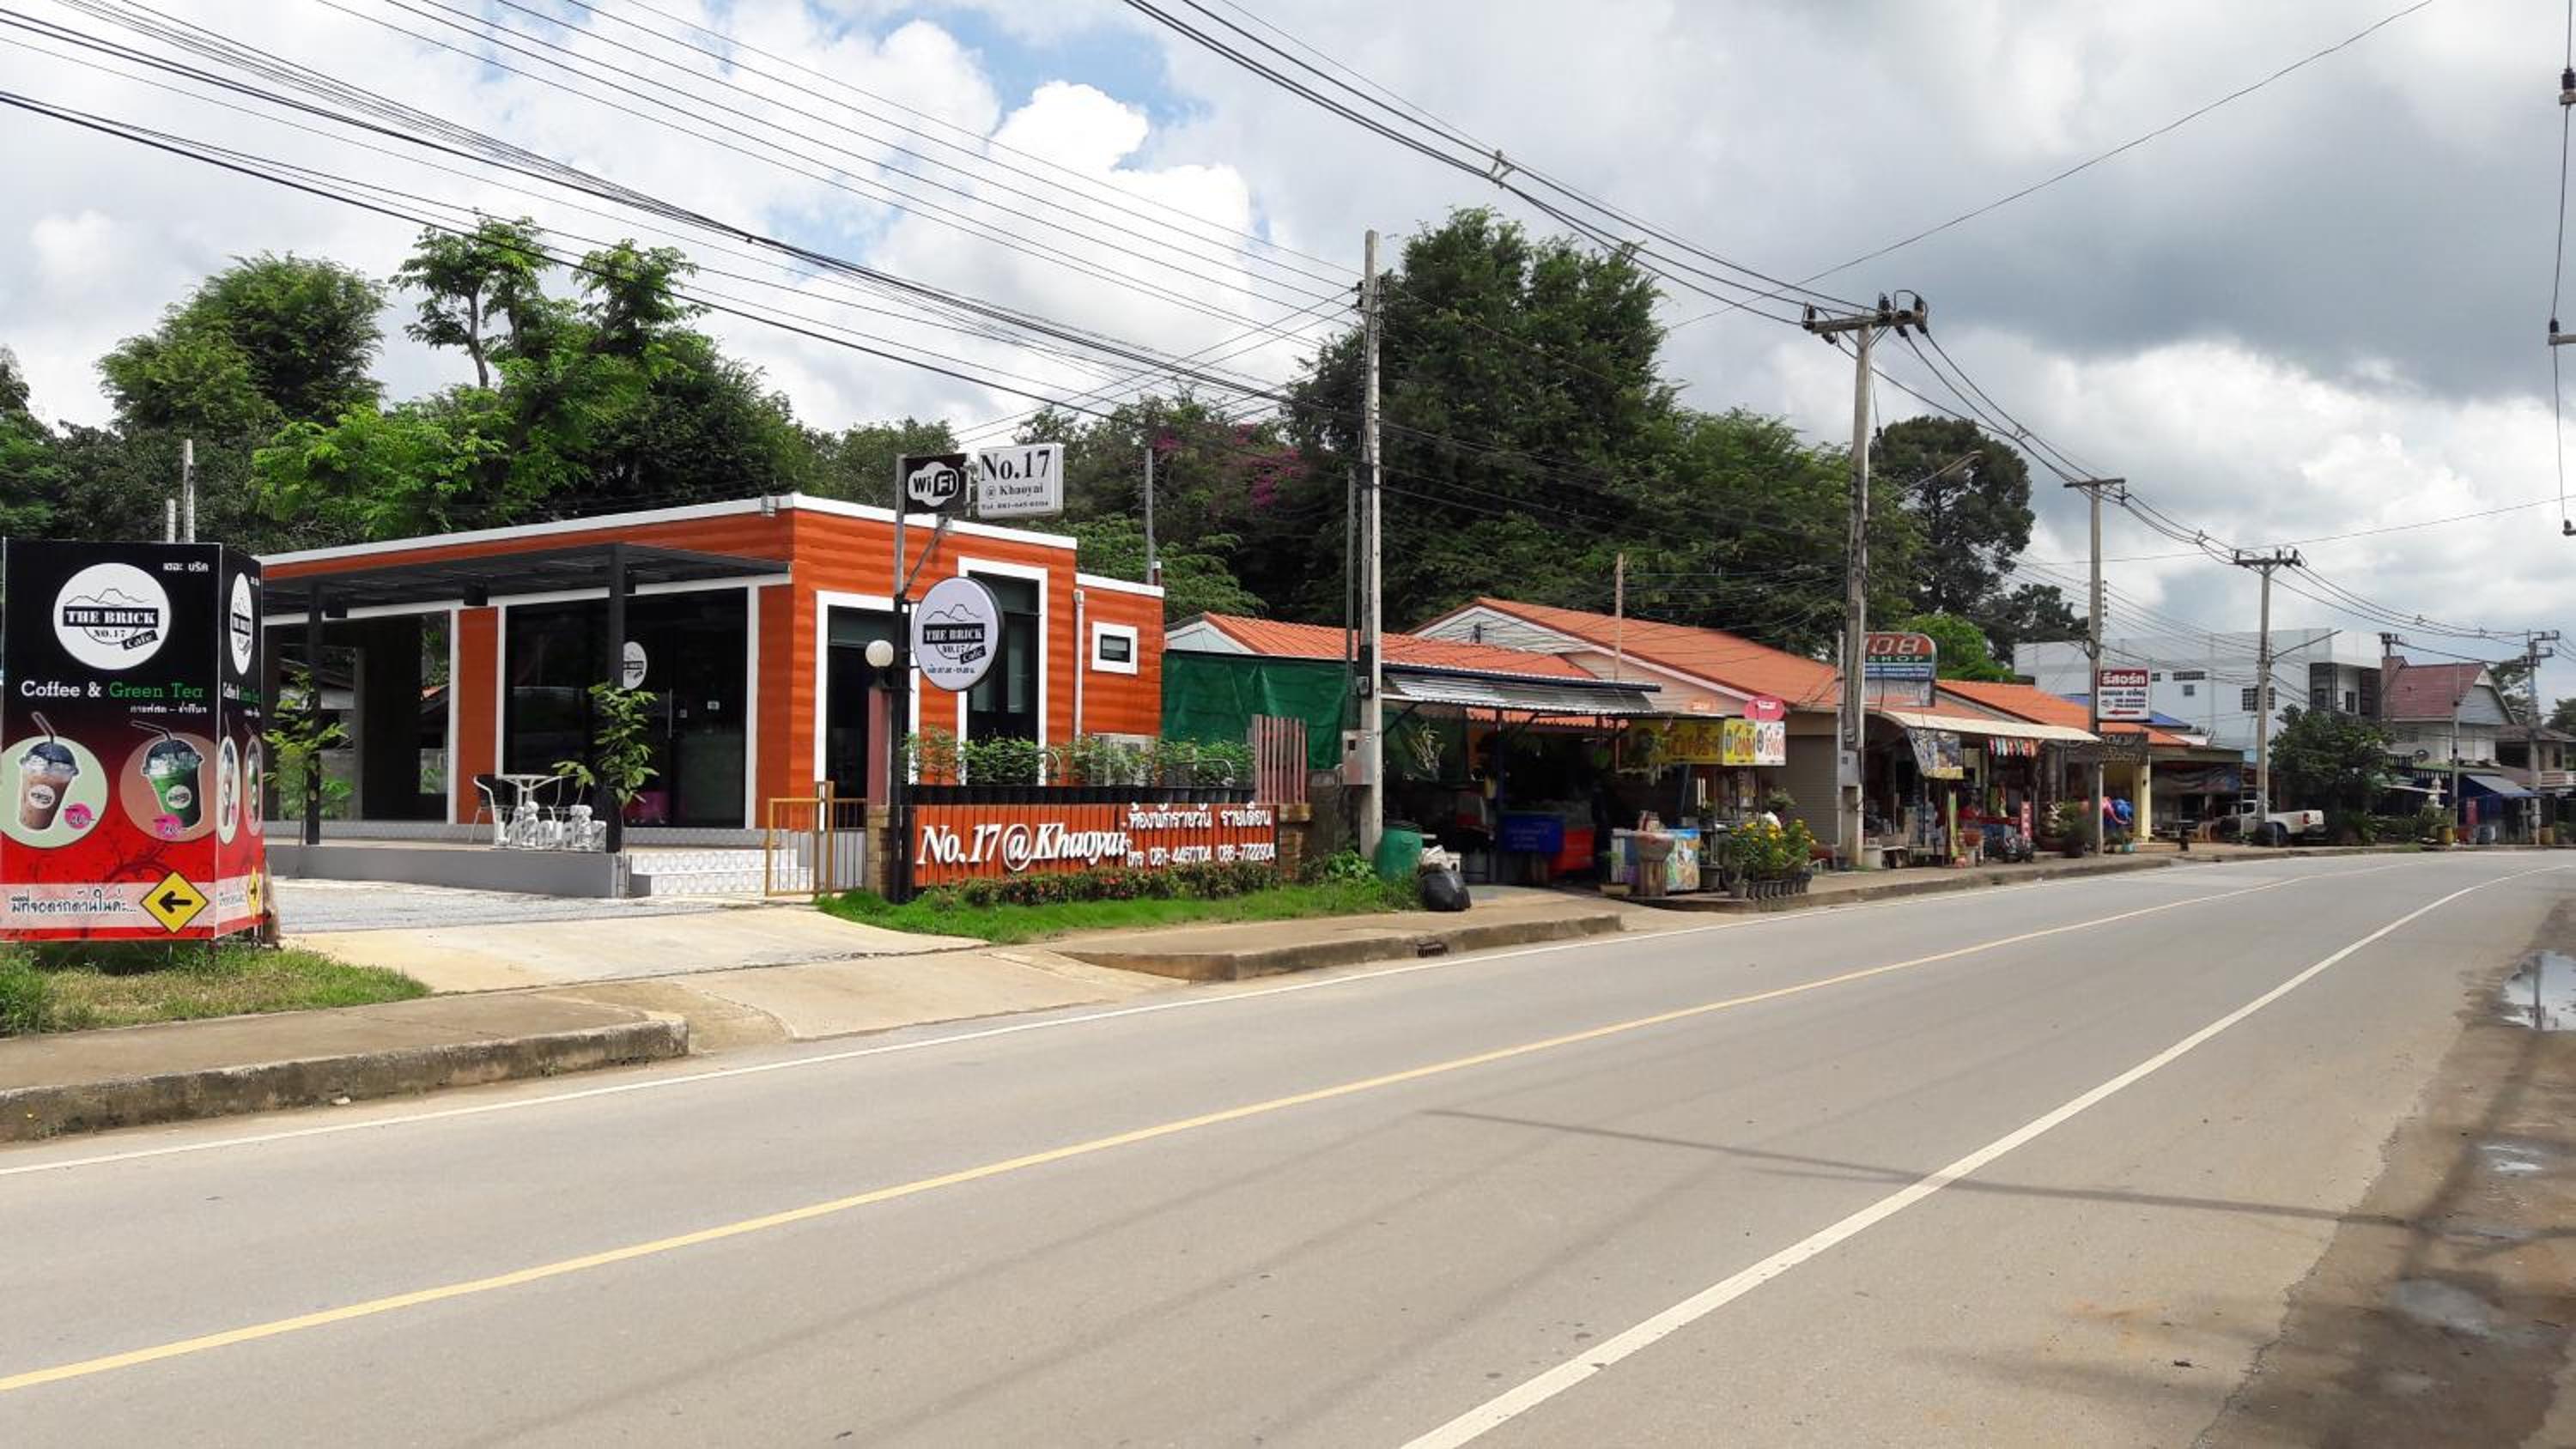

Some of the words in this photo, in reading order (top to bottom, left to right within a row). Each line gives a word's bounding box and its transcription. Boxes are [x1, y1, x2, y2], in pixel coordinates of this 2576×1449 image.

[980, 449, 1050, 482] No.17
[999, 483, 1043, 497] Khaoyai
[66, 609, 100, 624] THE
[104, 610, 156, 625] BRICK
[94, 629, 126, 638] NO.17
[926, 628, 947, 641] THE
[949, 627, 983, 640] BRICK
[2101, 672, 2146, 686] รีสอร์ท
[21, 680, 81, 698] Coffee
[88, 681, 102, 698] &
[109, 682, 164, 698] Green
[171, 682, 204, 698] Tea
[1127, 801, 1212, 829] ห้องพักรายวัน
[1220, 800, 1272, 828] รายเดือน
